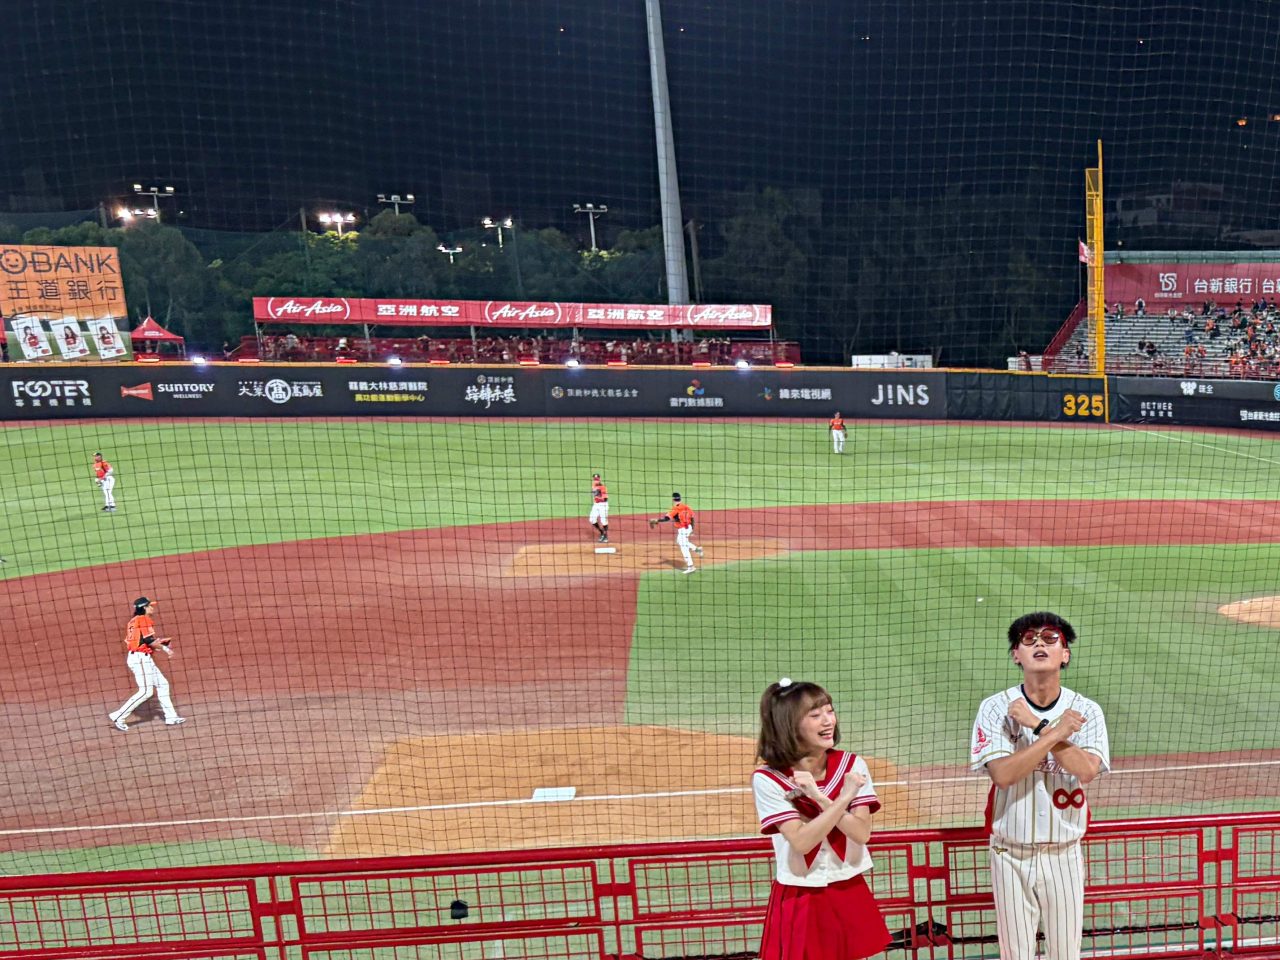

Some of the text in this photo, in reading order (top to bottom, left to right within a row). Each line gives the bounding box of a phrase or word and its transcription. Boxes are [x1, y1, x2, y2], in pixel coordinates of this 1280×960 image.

[7, 280, 118, 301] 王道銀行
[1194, 278, 1252, 294] 台新銀行
[377, 304, 460, 318] 亞洲航空
[587, 308, 665, 321] 亞洲航空
[12, 380, 91, 397] FOOTER
[1064, 394, 1104, 417] 325
